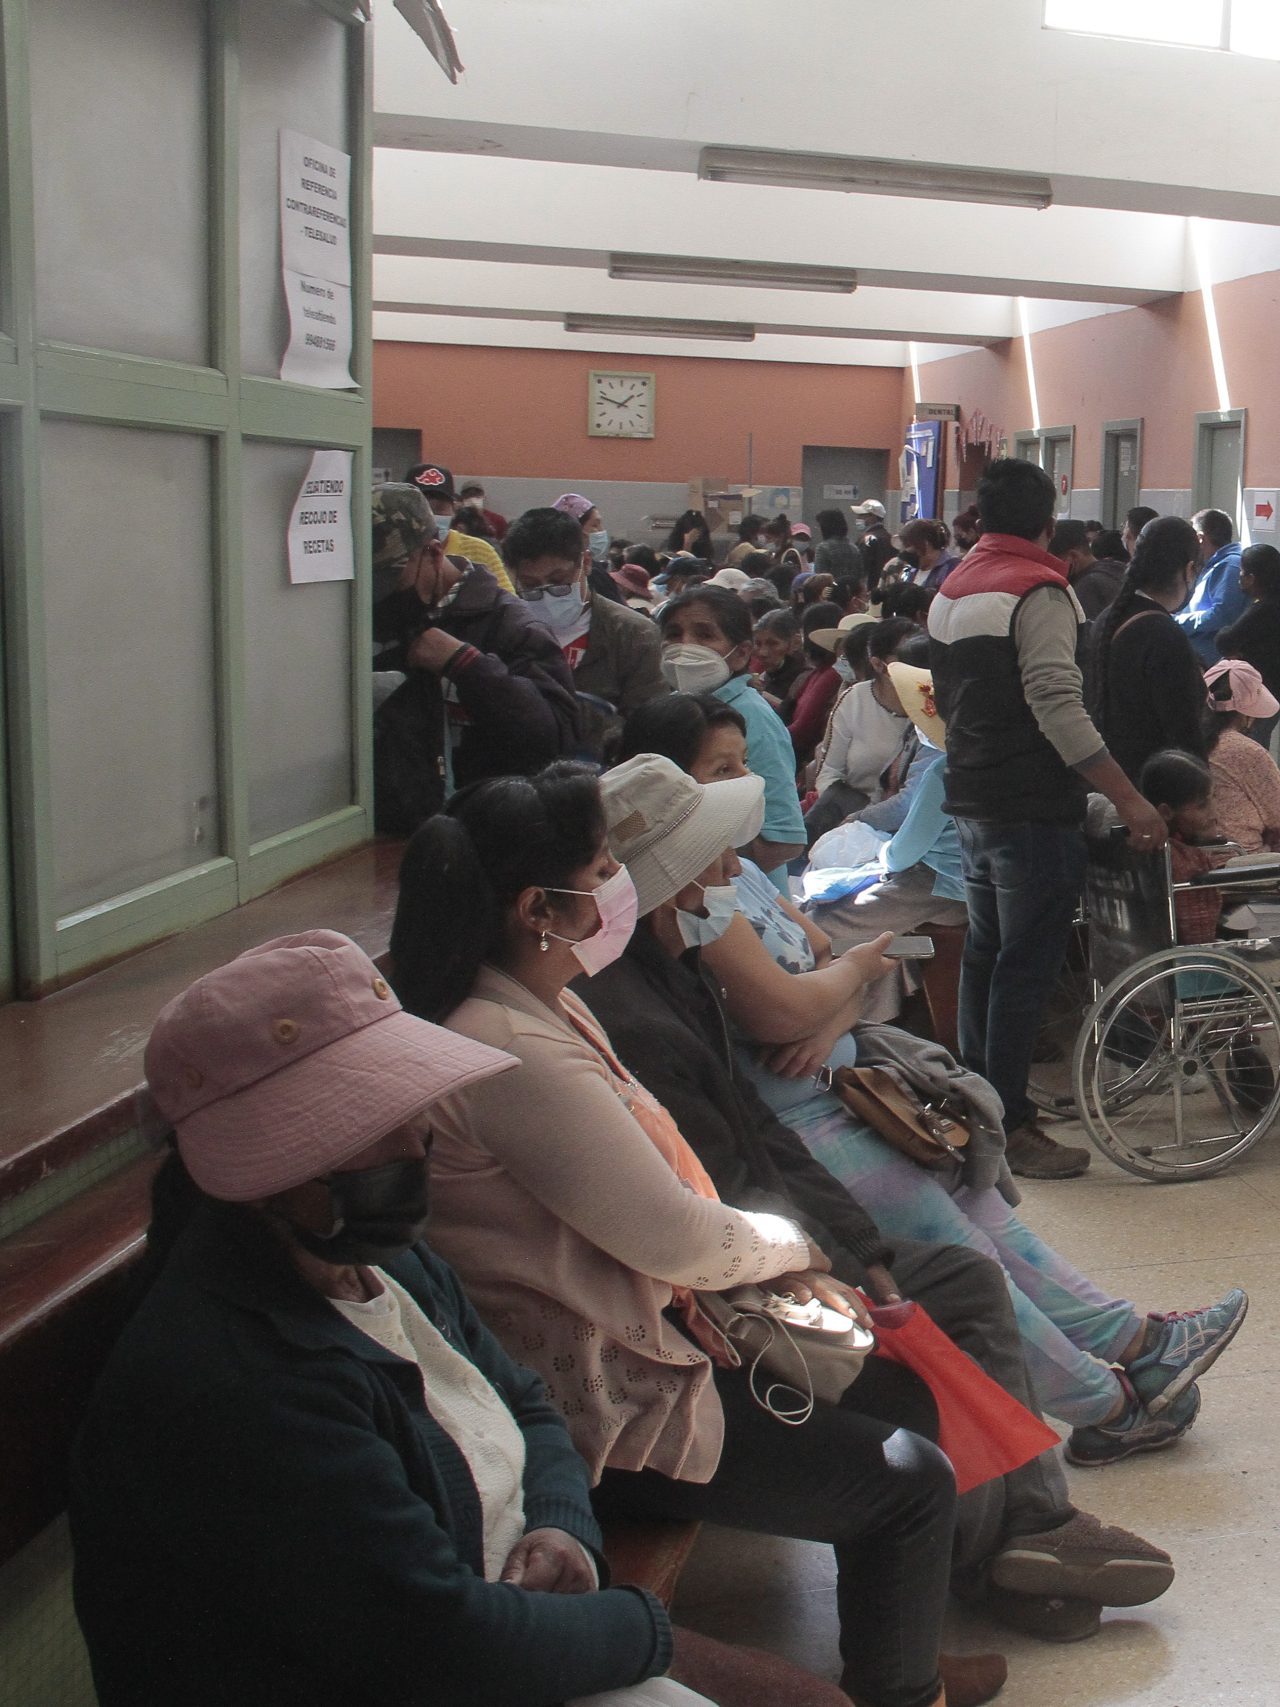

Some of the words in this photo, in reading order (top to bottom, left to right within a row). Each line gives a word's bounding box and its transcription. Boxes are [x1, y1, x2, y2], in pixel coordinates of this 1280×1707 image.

[303, 156, 328, 174] OFICINA
[328, 166, 336, 179] DE
[301, 177, 337, 200] REFERENCIA
[299, 510, 327, 525] RECOJO
[328, 510, 337, 524] DE
[303, 539, 334, 554] RECETAS
